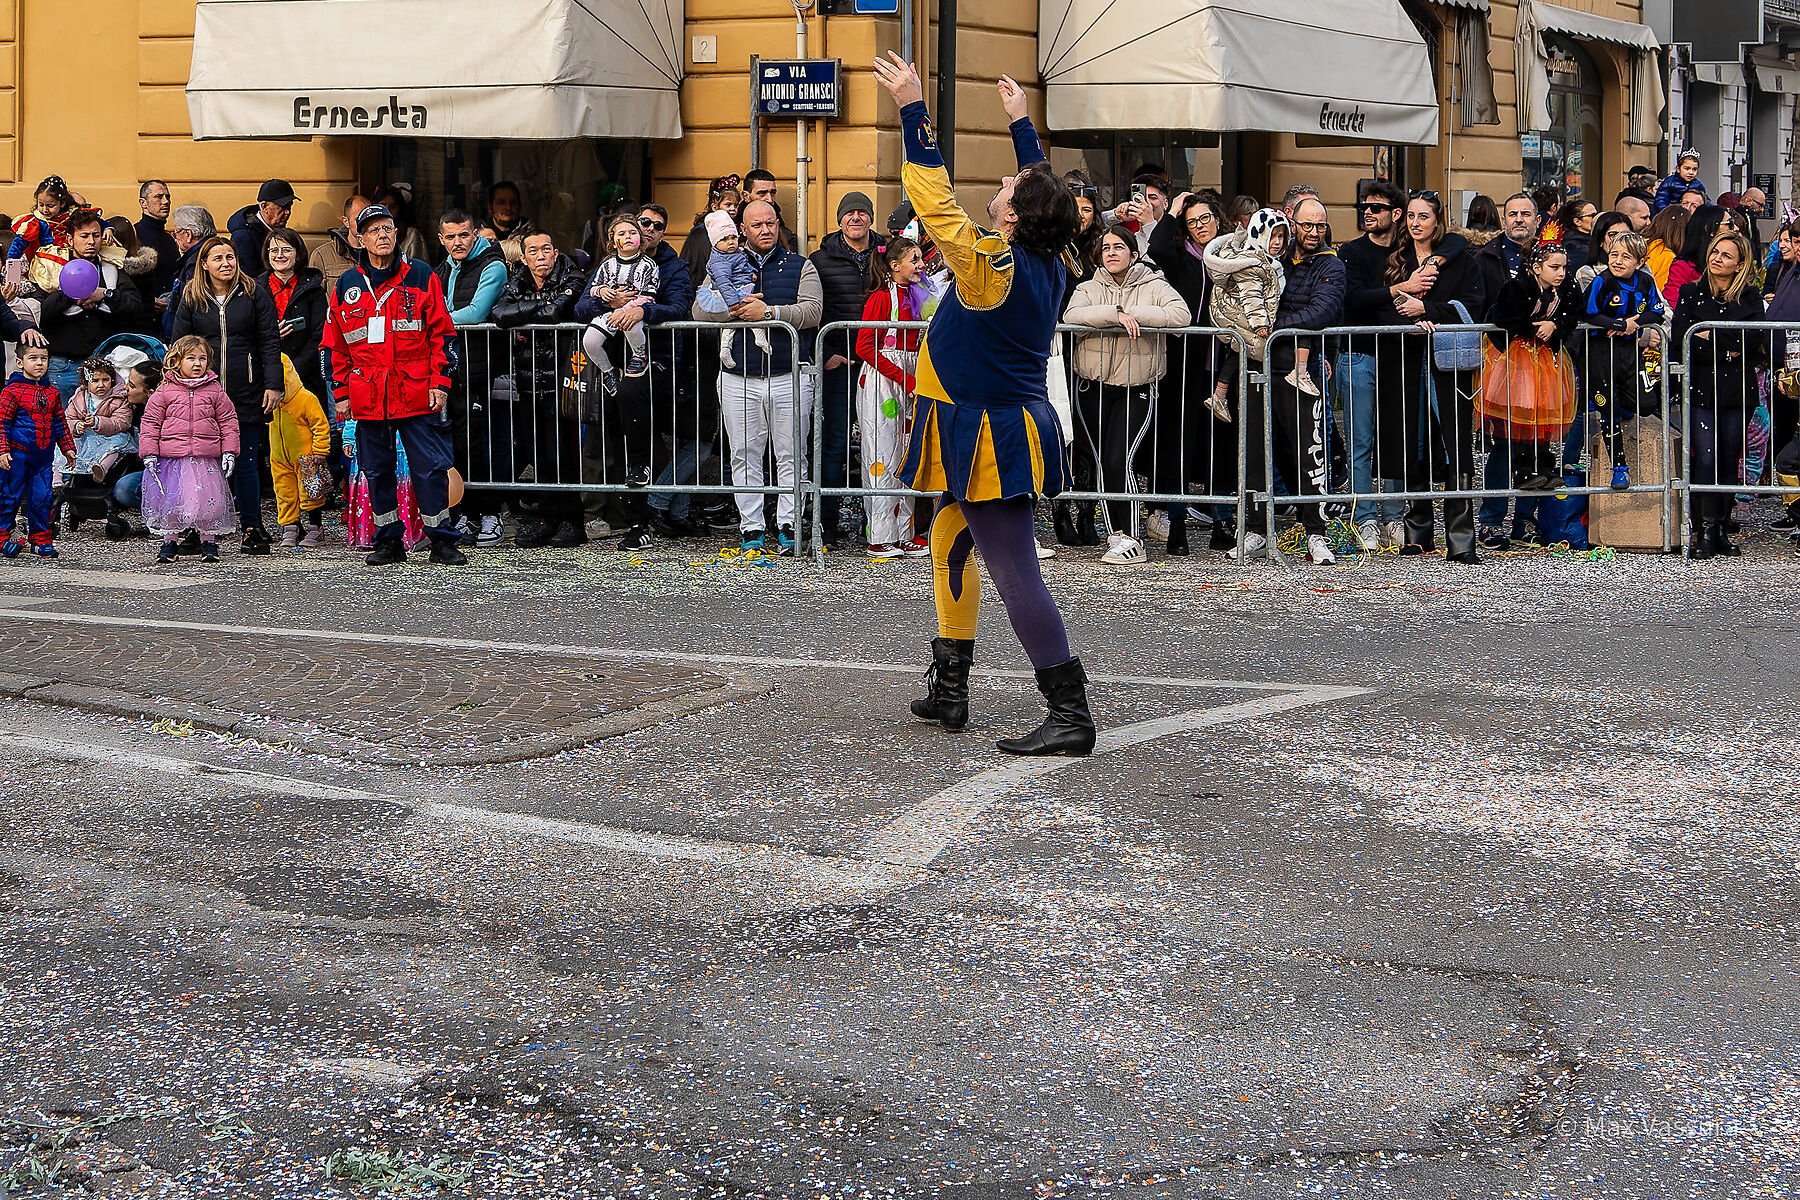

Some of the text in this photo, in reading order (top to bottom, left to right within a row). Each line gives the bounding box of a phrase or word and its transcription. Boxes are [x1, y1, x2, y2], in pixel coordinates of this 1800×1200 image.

[788, 65, 807, 78] VIA
[761, 82, 834, 100] ANTONIO GRAMSCI
[292, 95, 429, 130] Ernesta
[1319, 102, 1366, 133] Ernesta
